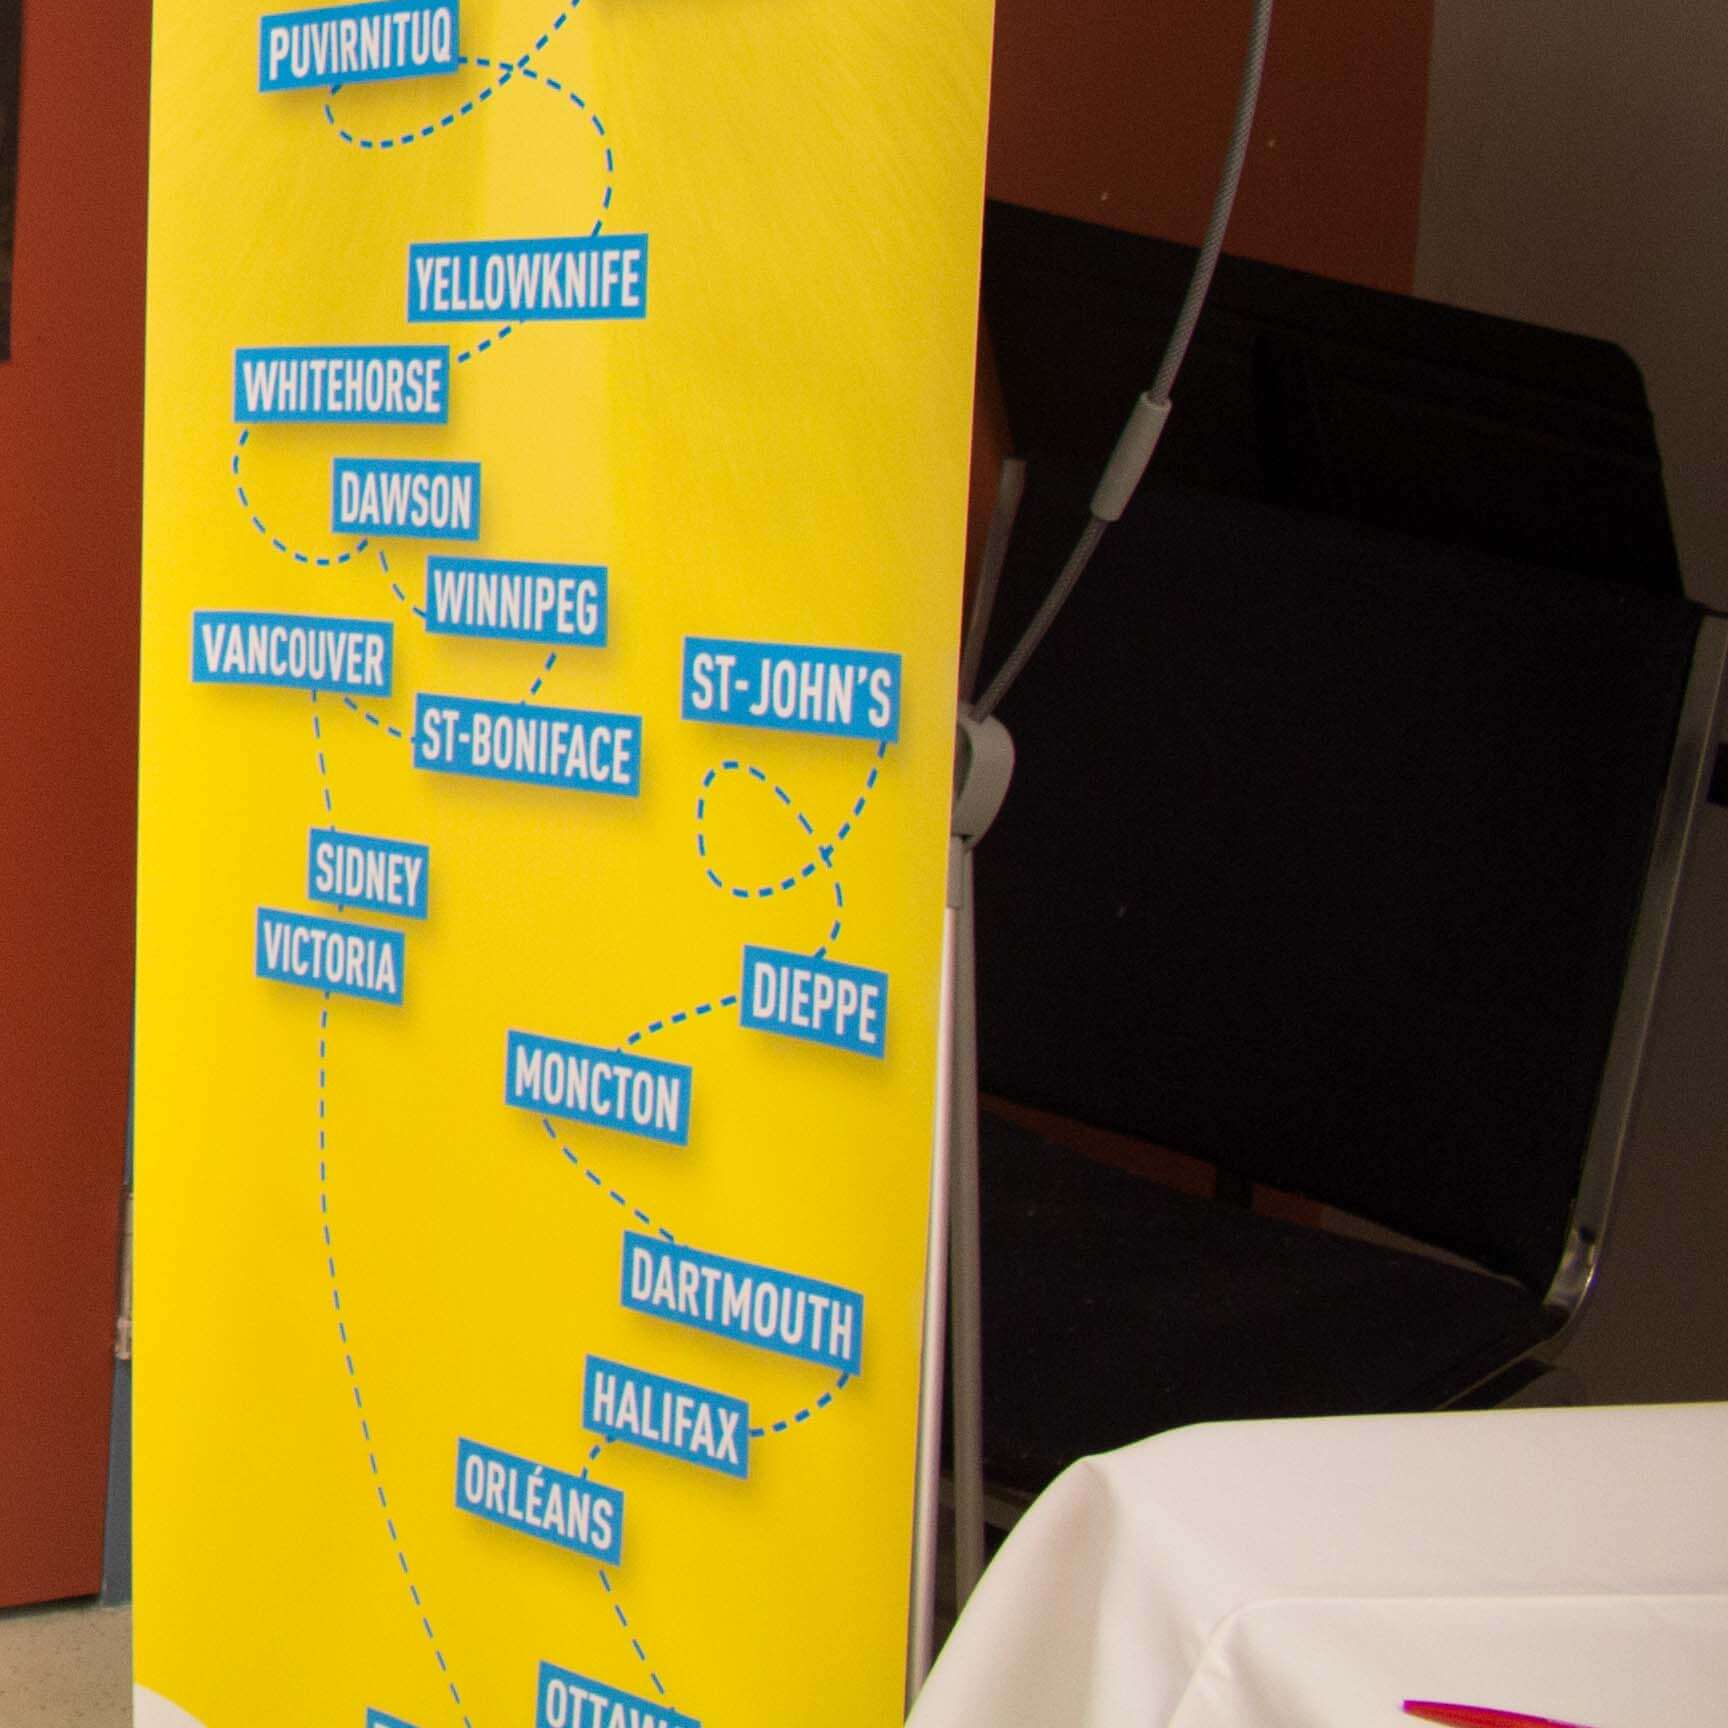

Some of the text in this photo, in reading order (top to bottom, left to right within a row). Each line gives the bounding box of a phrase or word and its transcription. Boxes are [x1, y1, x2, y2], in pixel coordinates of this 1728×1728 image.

[268, 5, 453, 81] PUVIRNITUQ
[415, 248, 640, 312] YELLOWKNIFE
[244, 358, 442, 413] WHITEHORSE
[341, 471, 472, 530] DAWSON
[433, 569, 598, 636] WINNIPEG
[202, 624, 384, 687] VANCOUVER
[692, 652, 892, 730] ST-JOHN'S
[421, 709, 632, 785] ST-BONIFACE
[315, 842, 422, 907] SIDNEY
[264, 921, 397, 995] VICTORIA
[752, 961, 878, 1045] DIEPPE
[515, 1047, 680, 1133] MONCTON
[632, 1246, 853, 1361] DARTMOUTH
[593, 1371, 739, 1465] HALIFAX
[465, 1454, 613, 1552] ORLÉANS
[546, 1678, 682, 1728] OTT
